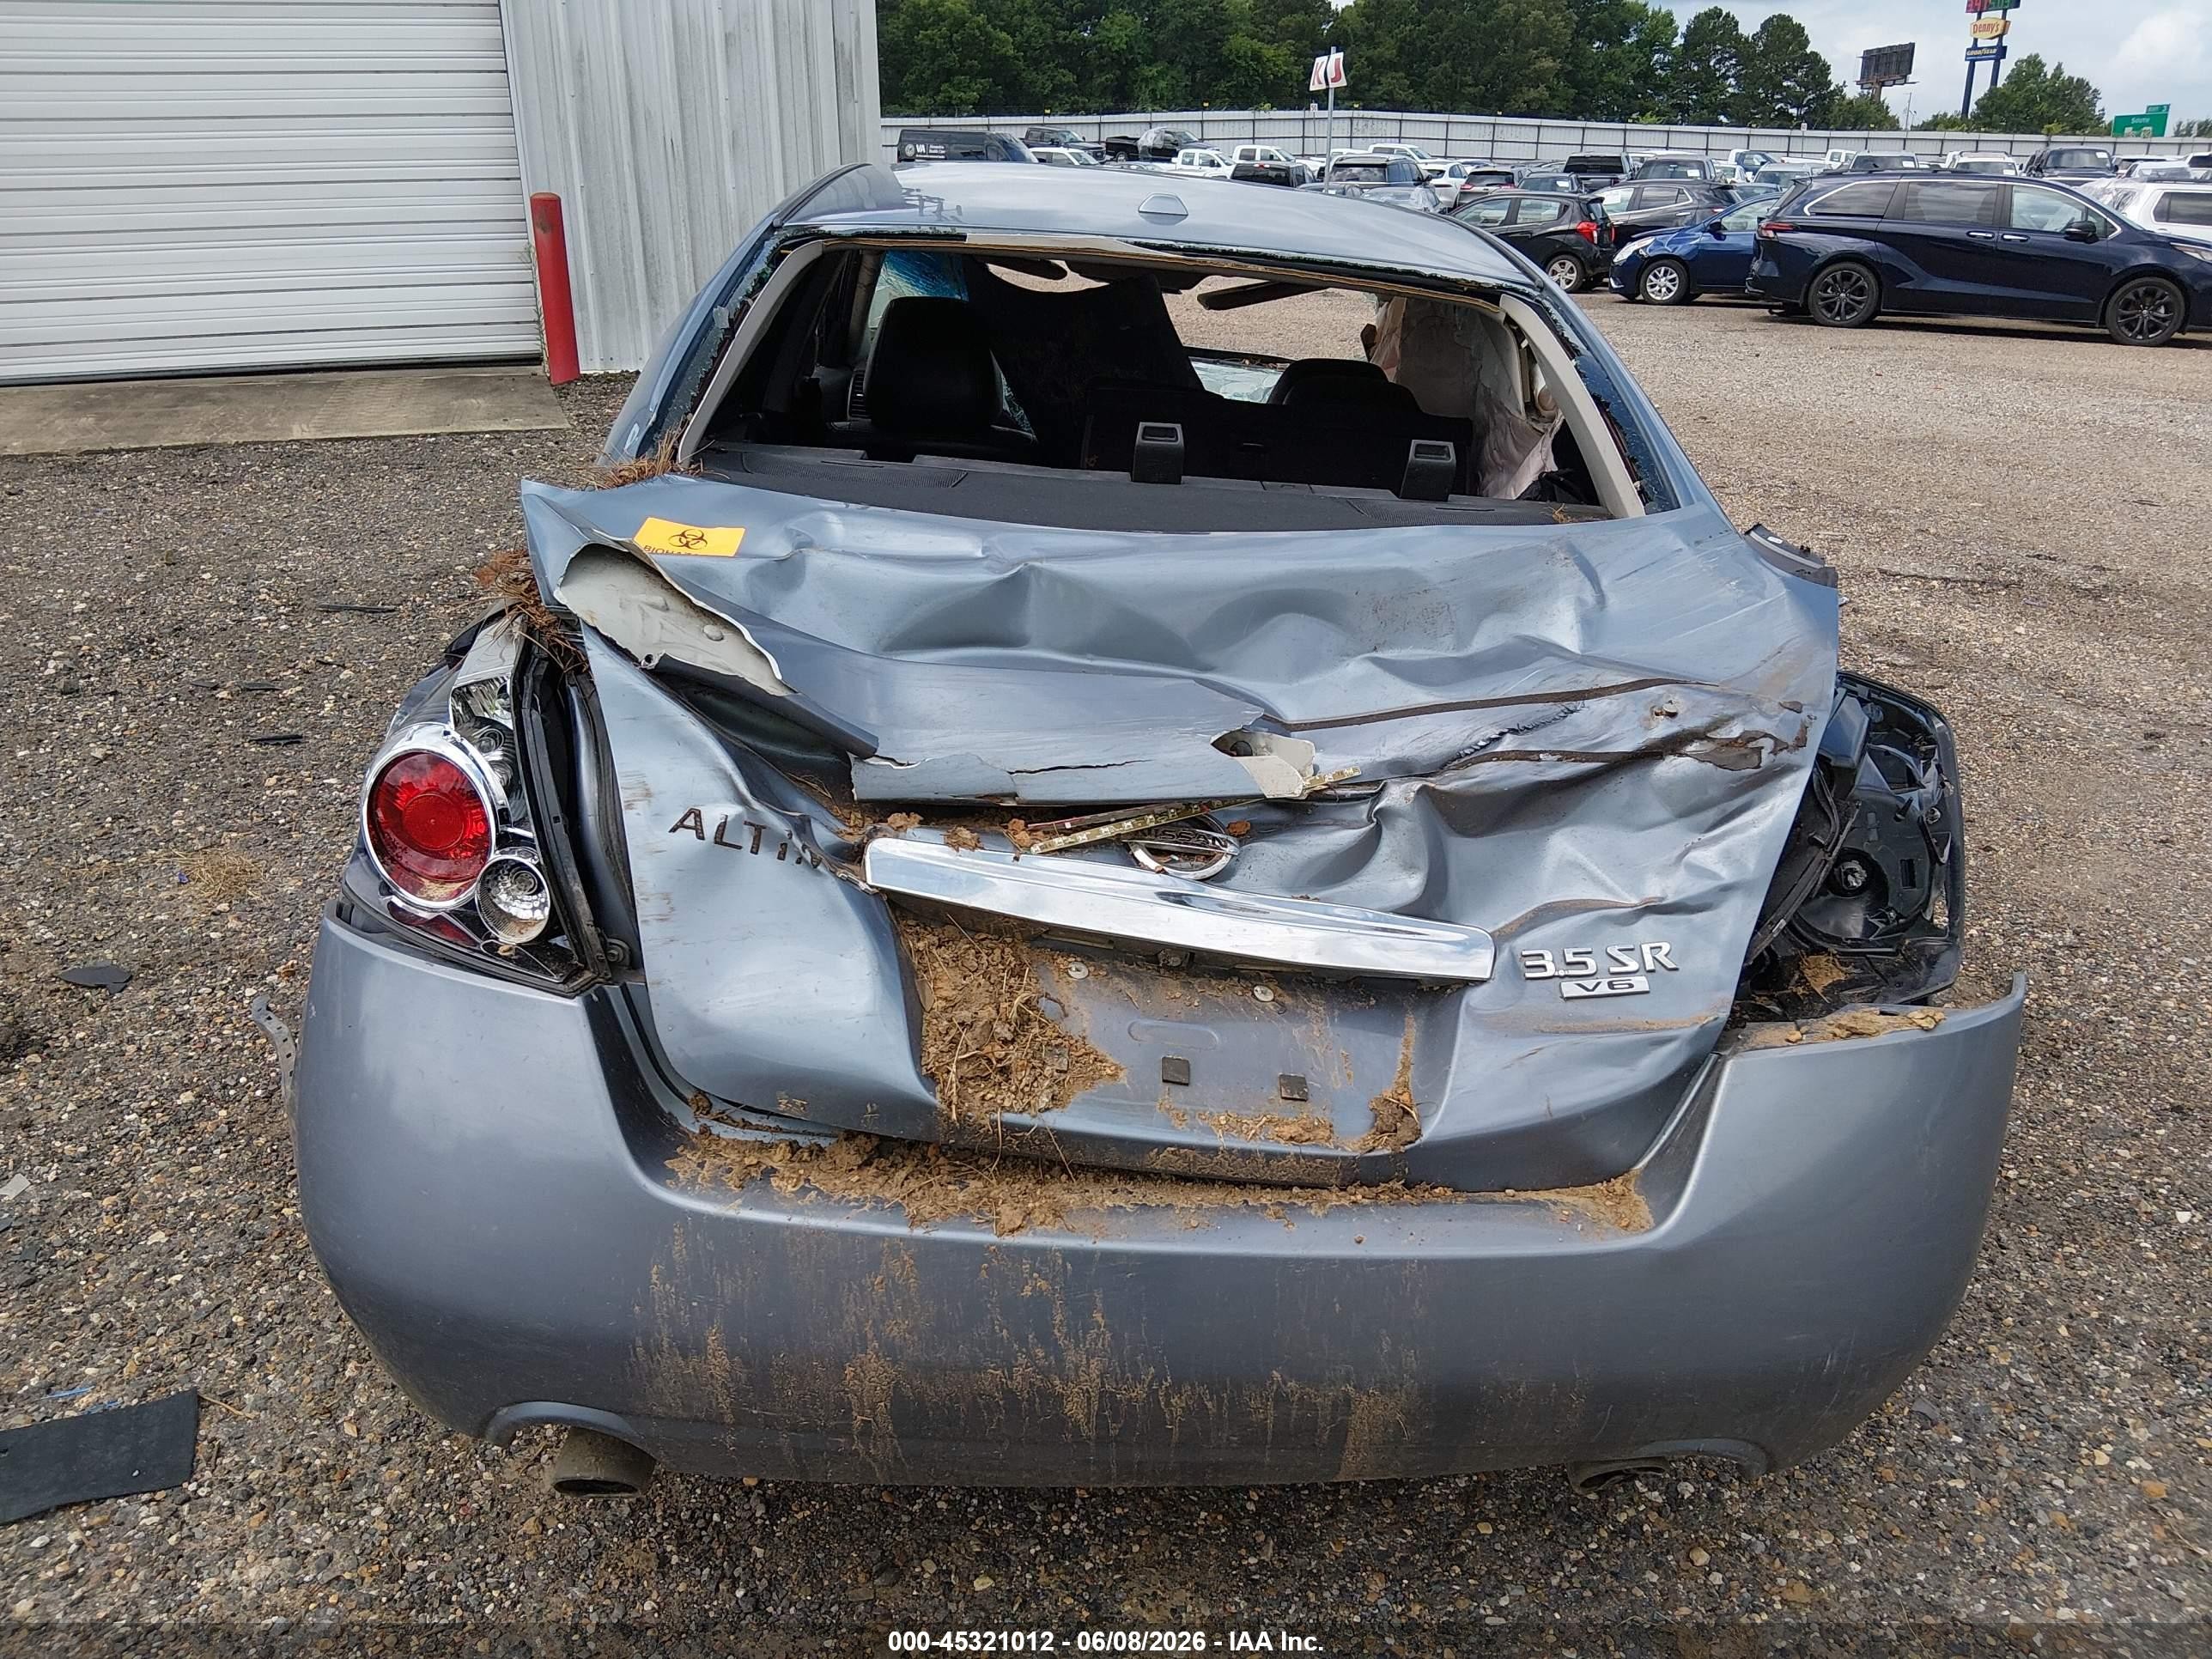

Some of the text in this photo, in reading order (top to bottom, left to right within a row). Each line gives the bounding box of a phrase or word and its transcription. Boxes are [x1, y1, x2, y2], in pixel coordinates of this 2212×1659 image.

[1972, 21, 2000, 34] Denny's
[1311, 61, 1324, 86] K
[1330, 58, 1342, 83] J
[915, 143, 926, 153] VA
[1521, 941, 1680, 980] 3.5 SR
[1574, 979, 1635, 992] V6
